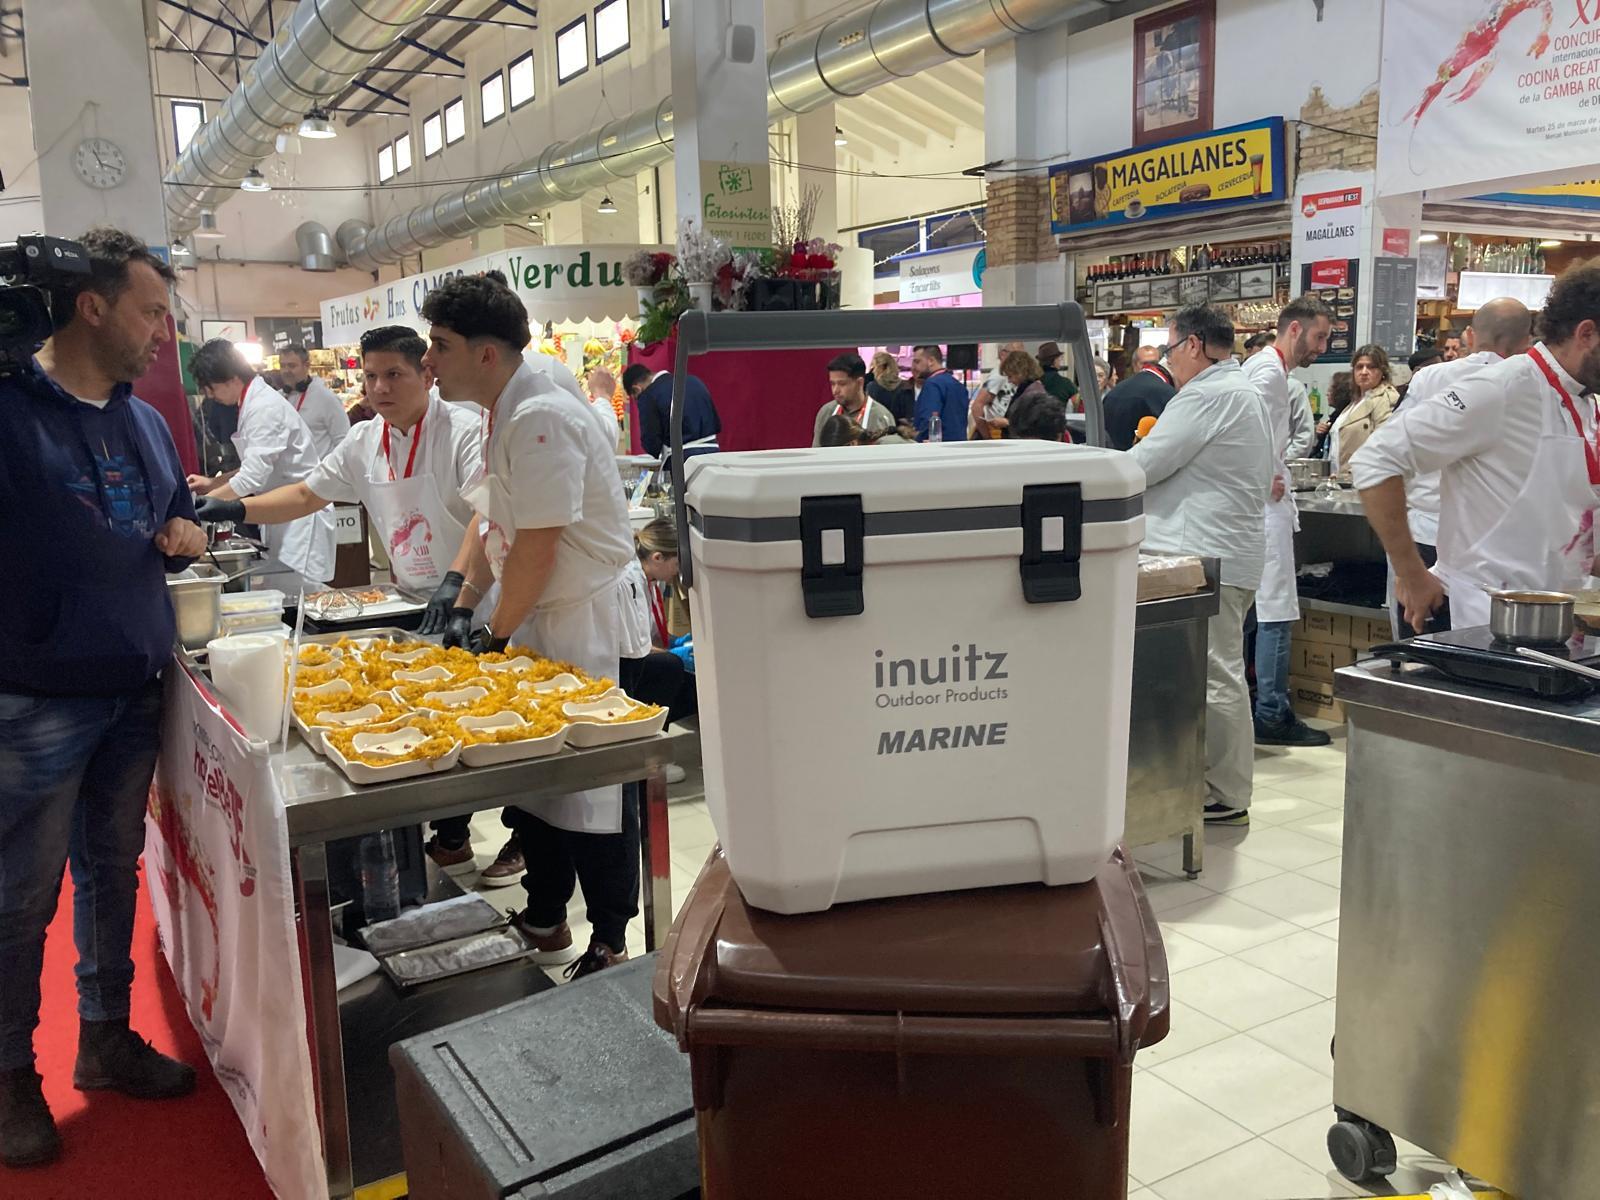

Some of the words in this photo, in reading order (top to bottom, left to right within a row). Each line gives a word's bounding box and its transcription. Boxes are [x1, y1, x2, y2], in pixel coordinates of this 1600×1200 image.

[1552, 47, 1600, 63] internacion
[1517, 67, 1560, 88] COCINA
[1563, 58, 1600, 79] CREAT
[1519, 94, 1531, 104] de
[1532, 93, 1541, 103] la
[1543, 79, 1584, 100] GAMBA
[1578, 98, 1590, 108] de
[1112, 138, 1248, 190] MAGALLANES
[1306, 225, 1355, 241] MAGALLANES
[330, 301, 360, 329] Frutas
[874, 643, 1009, 689] inuitz
[875, 690, 941, 708] Outdoor
[945, 686, 1009, 704] Products
[876, 722, 1009, 756] MARINE
